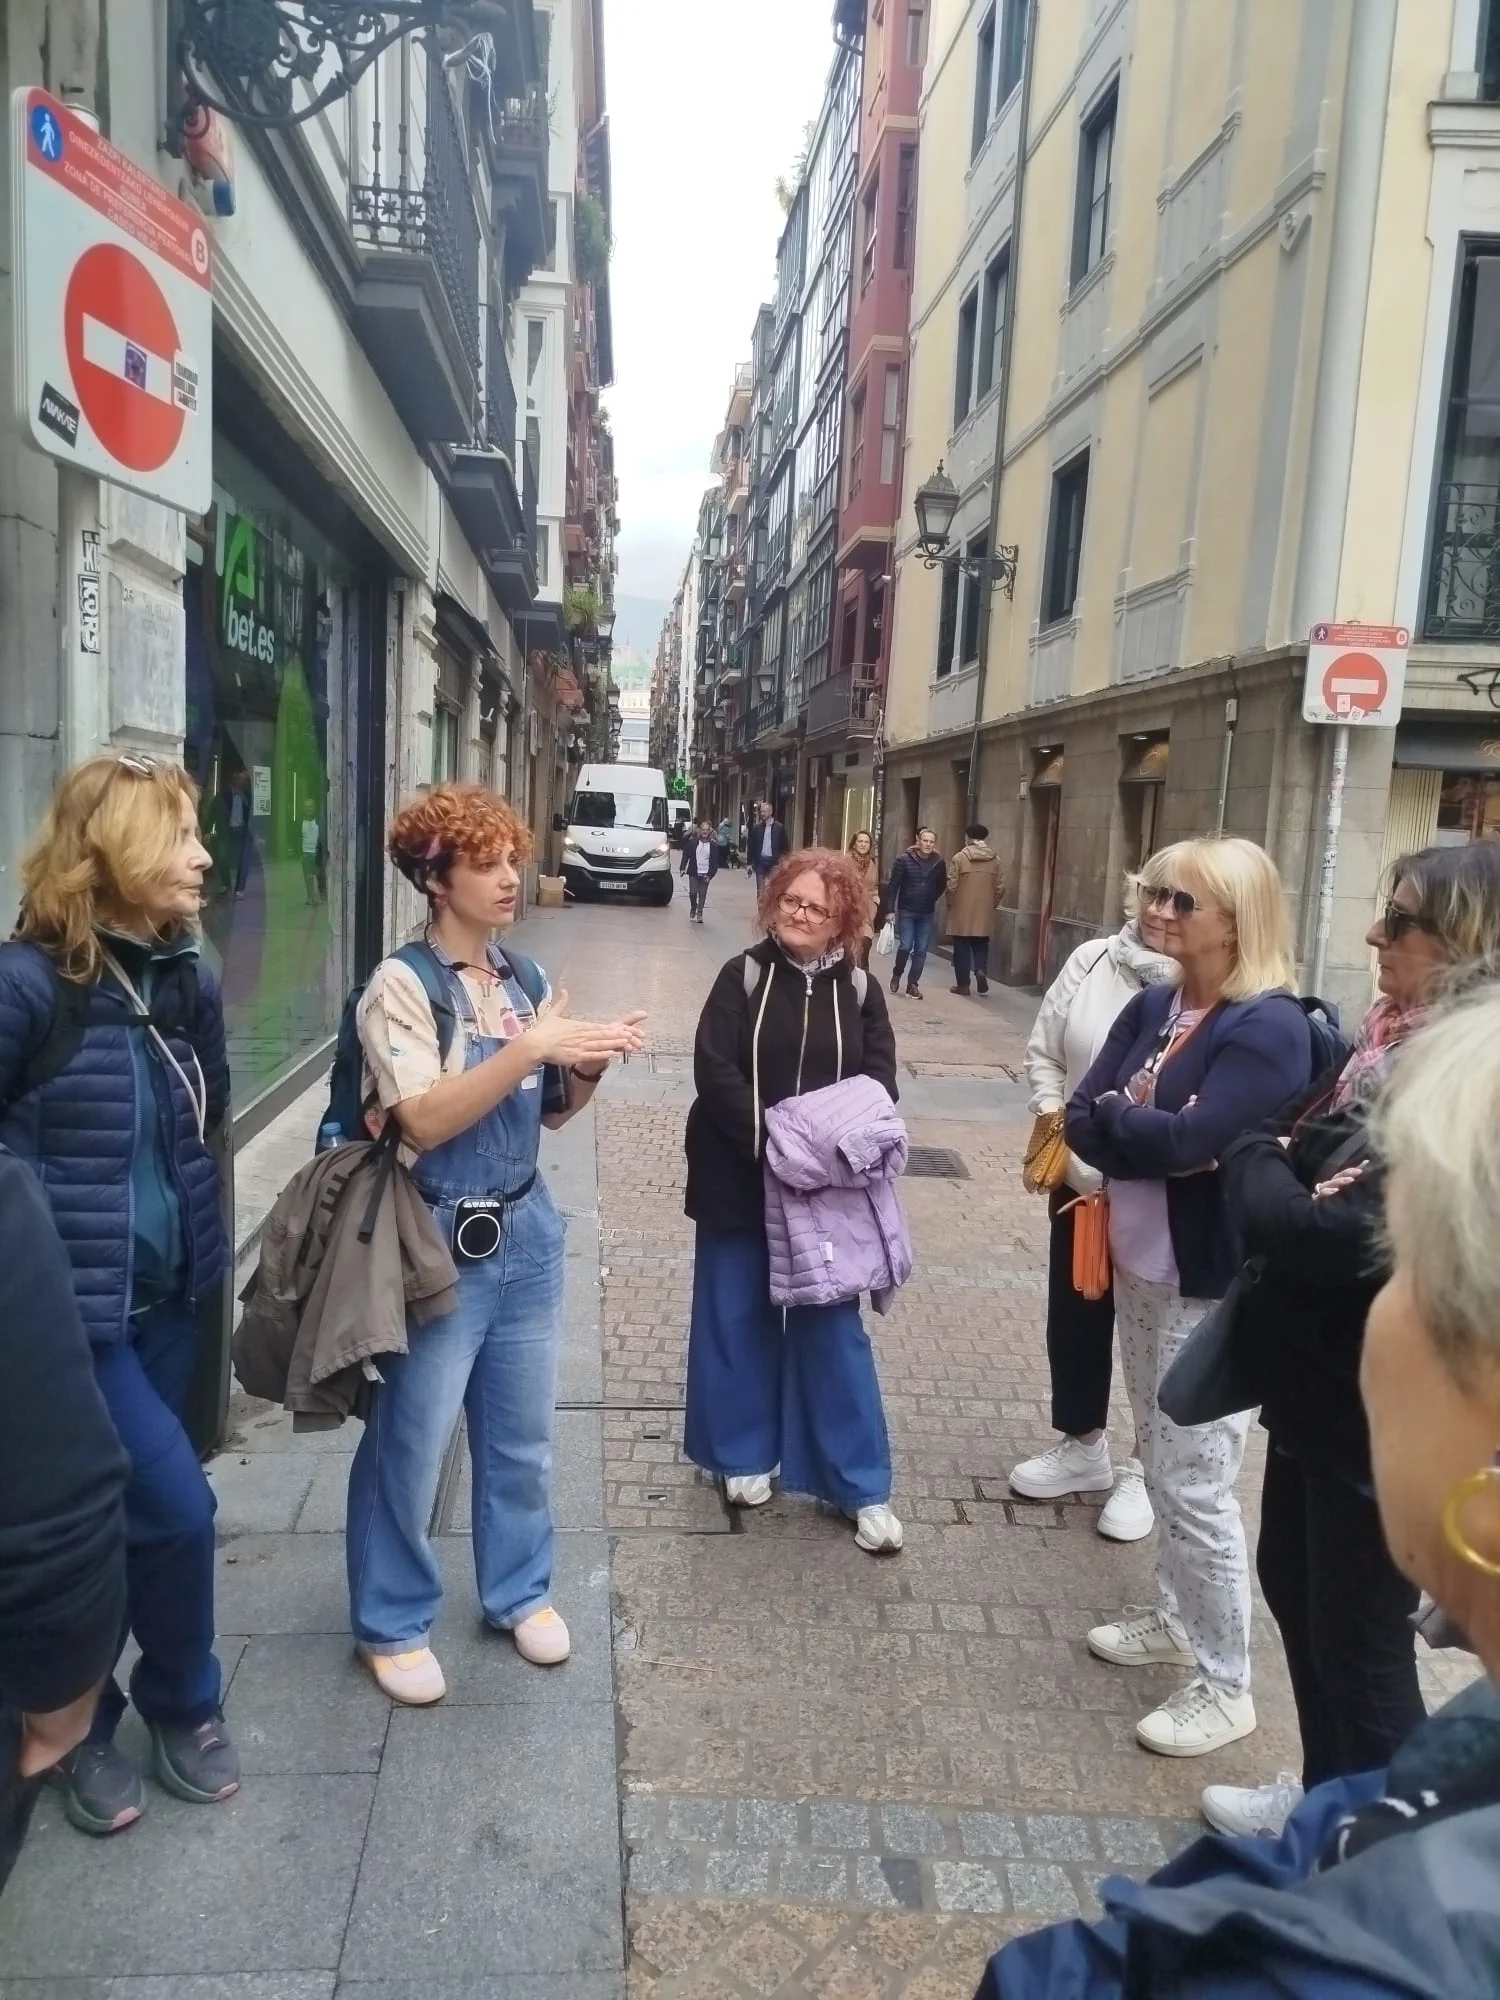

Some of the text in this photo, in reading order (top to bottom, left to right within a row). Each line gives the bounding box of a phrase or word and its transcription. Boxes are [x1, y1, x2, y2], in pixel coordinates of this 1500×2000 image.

[64, 160, 87, 188] ZONA
[90, 180, 100, 197] DE
[195, 238, 205, 265] B
[228, 595, 275, 664] bet.es
